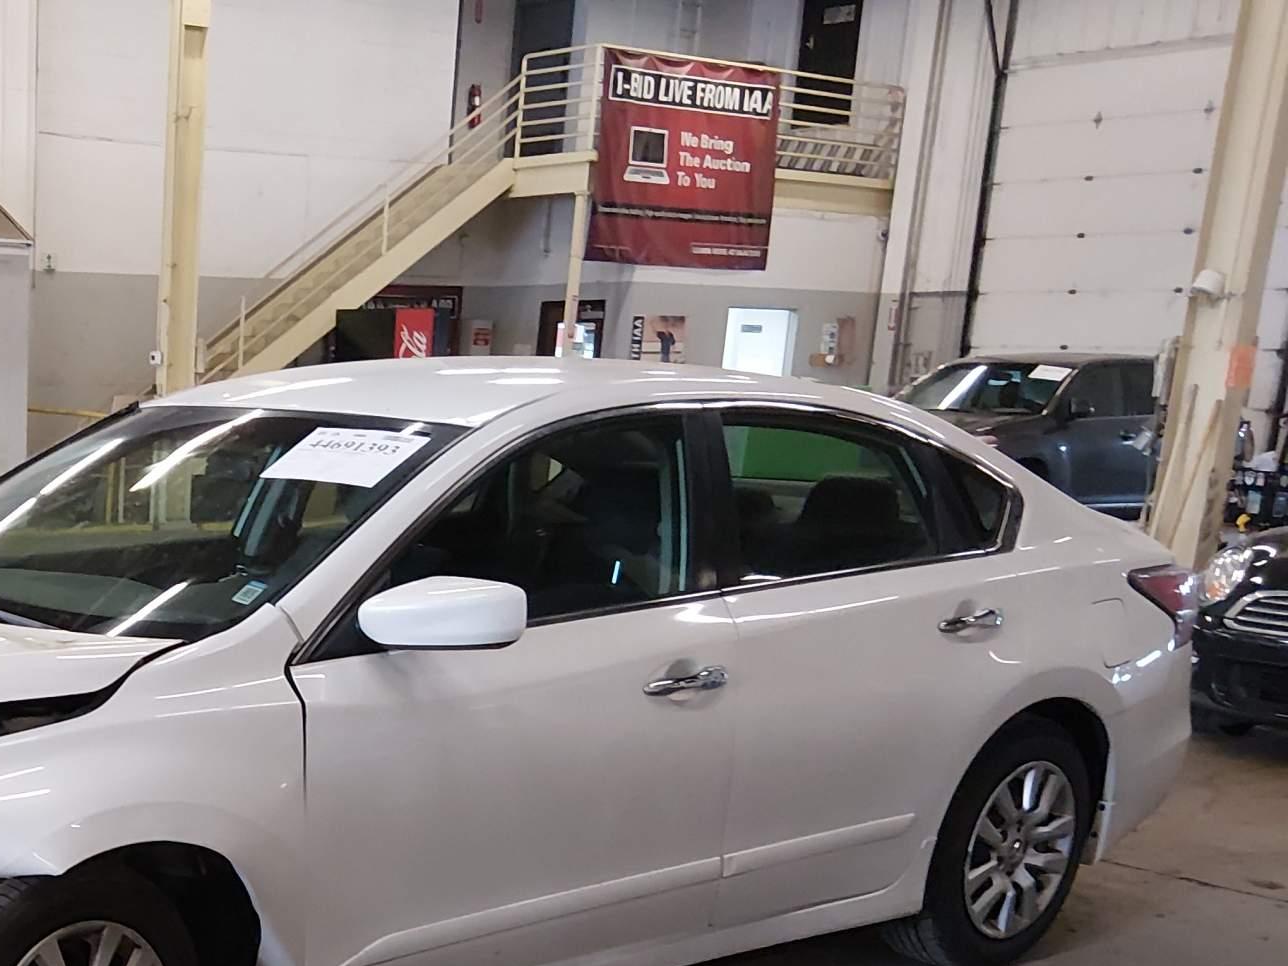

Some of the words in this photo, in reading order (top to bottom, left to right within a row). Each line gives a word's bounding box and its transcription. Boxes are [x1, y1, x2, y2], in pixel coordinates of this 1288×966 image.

[658, 78, 693, 105] LIVE
[695, 83, 739, 110] FROM
[680, 131, 698, 147] We
[700, 133, 734, 154] Bring
[678, 152, 700, 168] The
[702, 155, 751, 173] Auction
[676, 171, 691, 187] To
[694, 172, 716, 189] You
